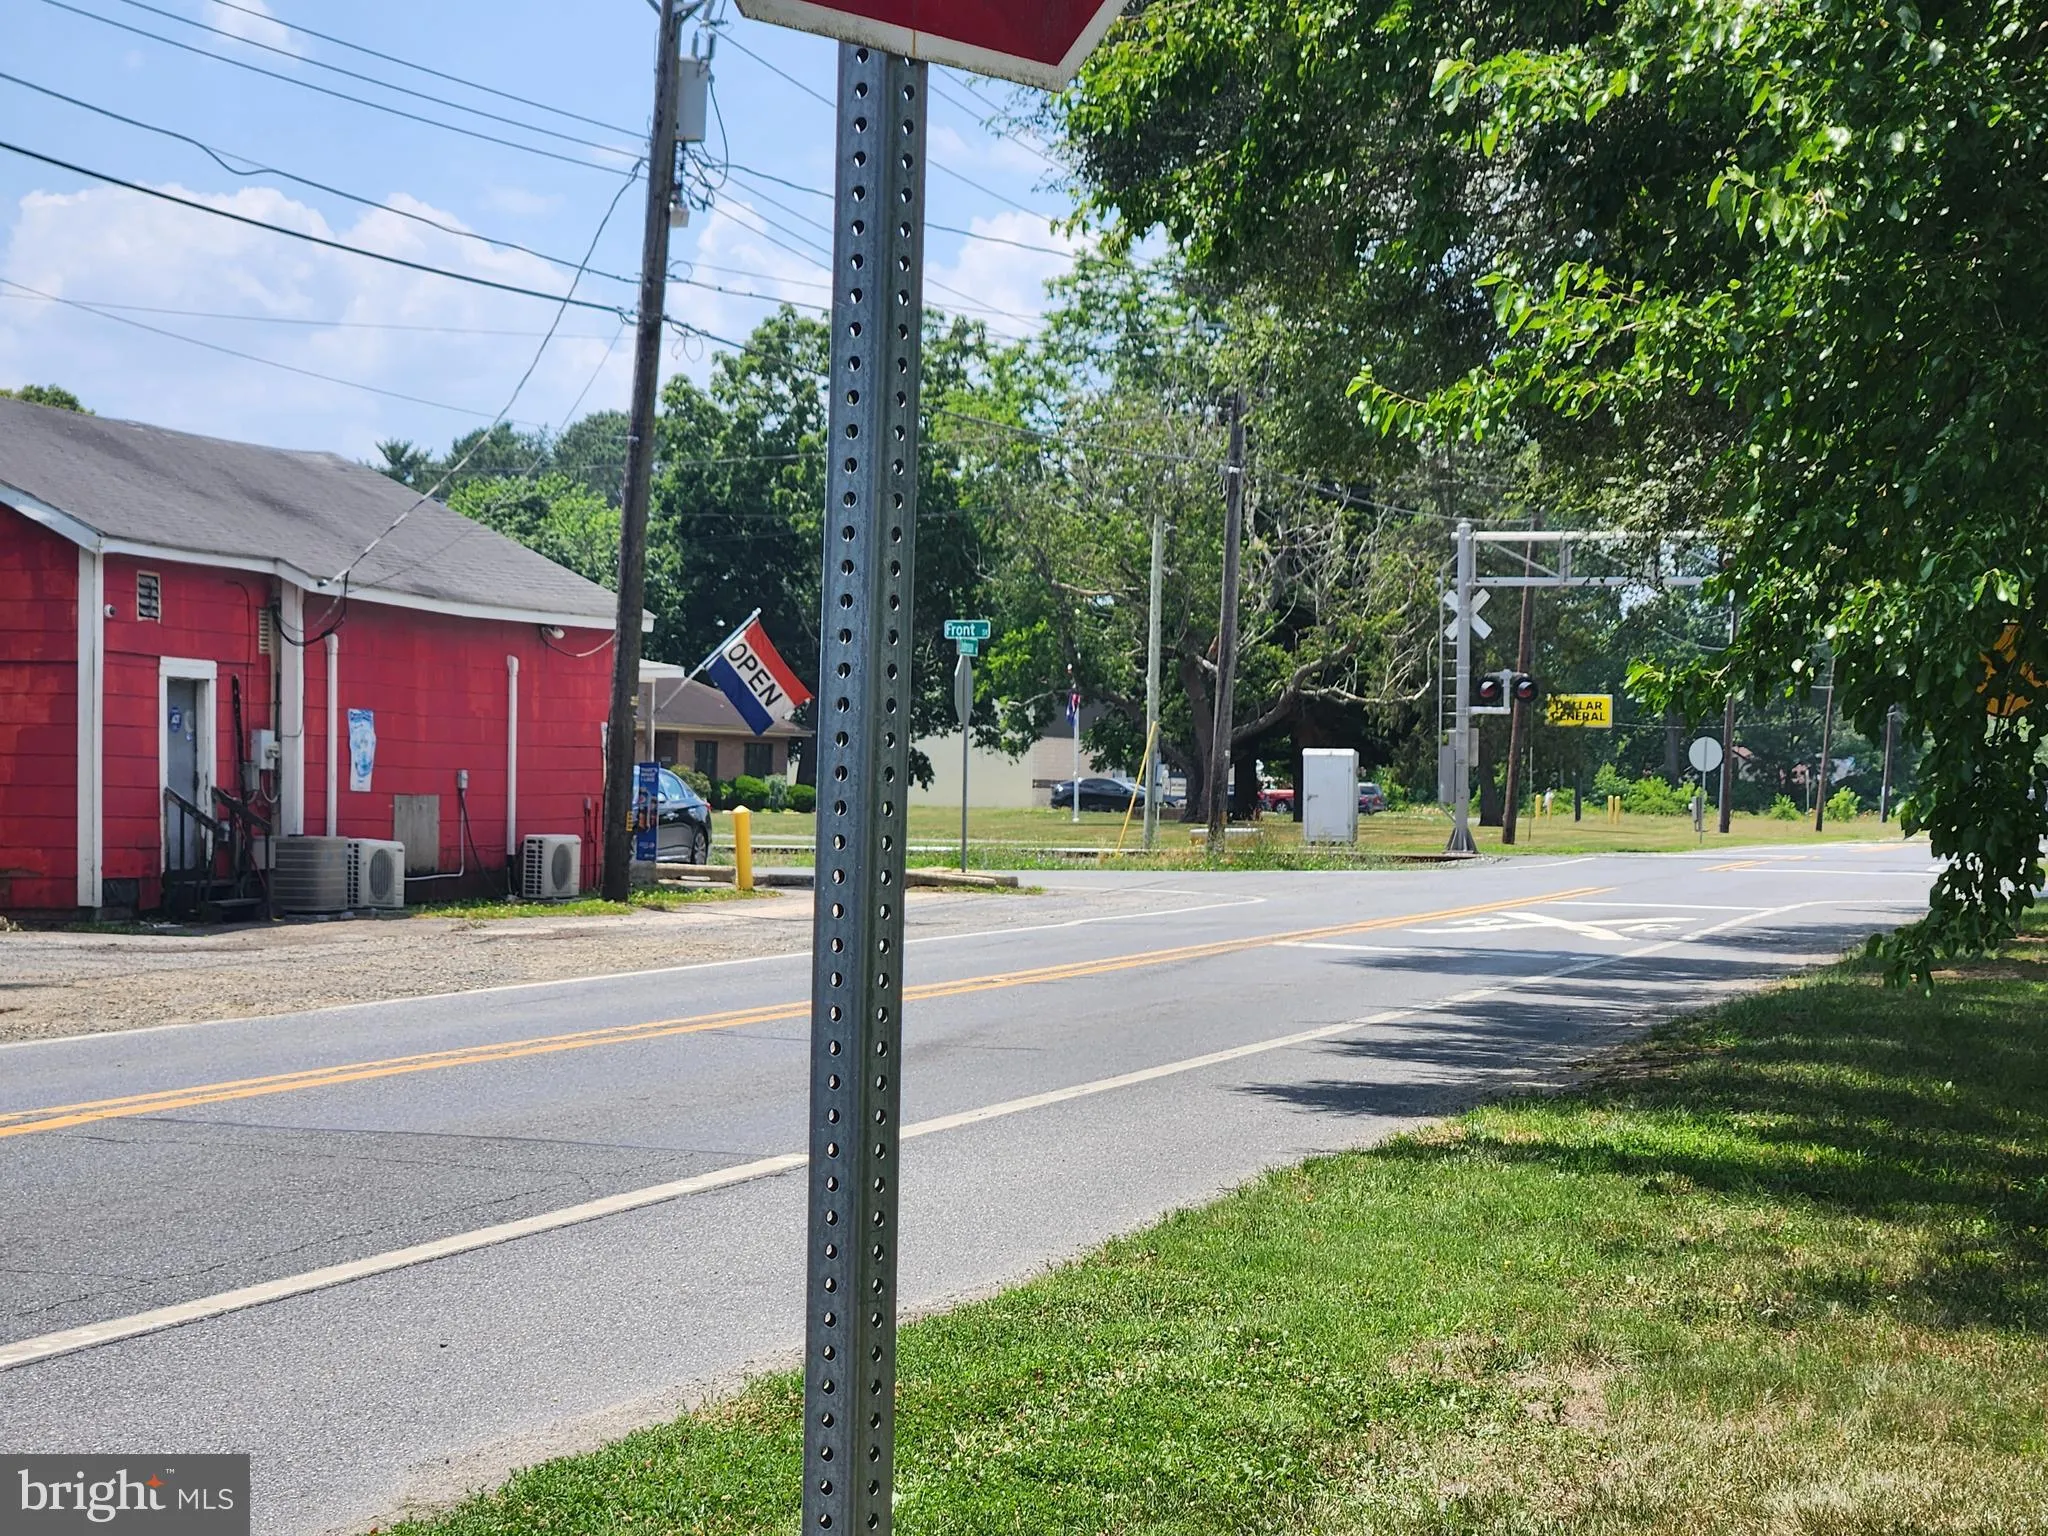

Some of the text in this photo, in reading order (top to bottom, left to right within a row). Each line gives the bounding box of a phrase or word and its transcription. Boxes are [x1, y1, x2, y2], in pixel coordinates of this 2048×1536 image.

[946, 623, 976, 636] Front
[728, 643, 783, 708] OPEN
[1550, 711, 1606, 721] GENERAL
